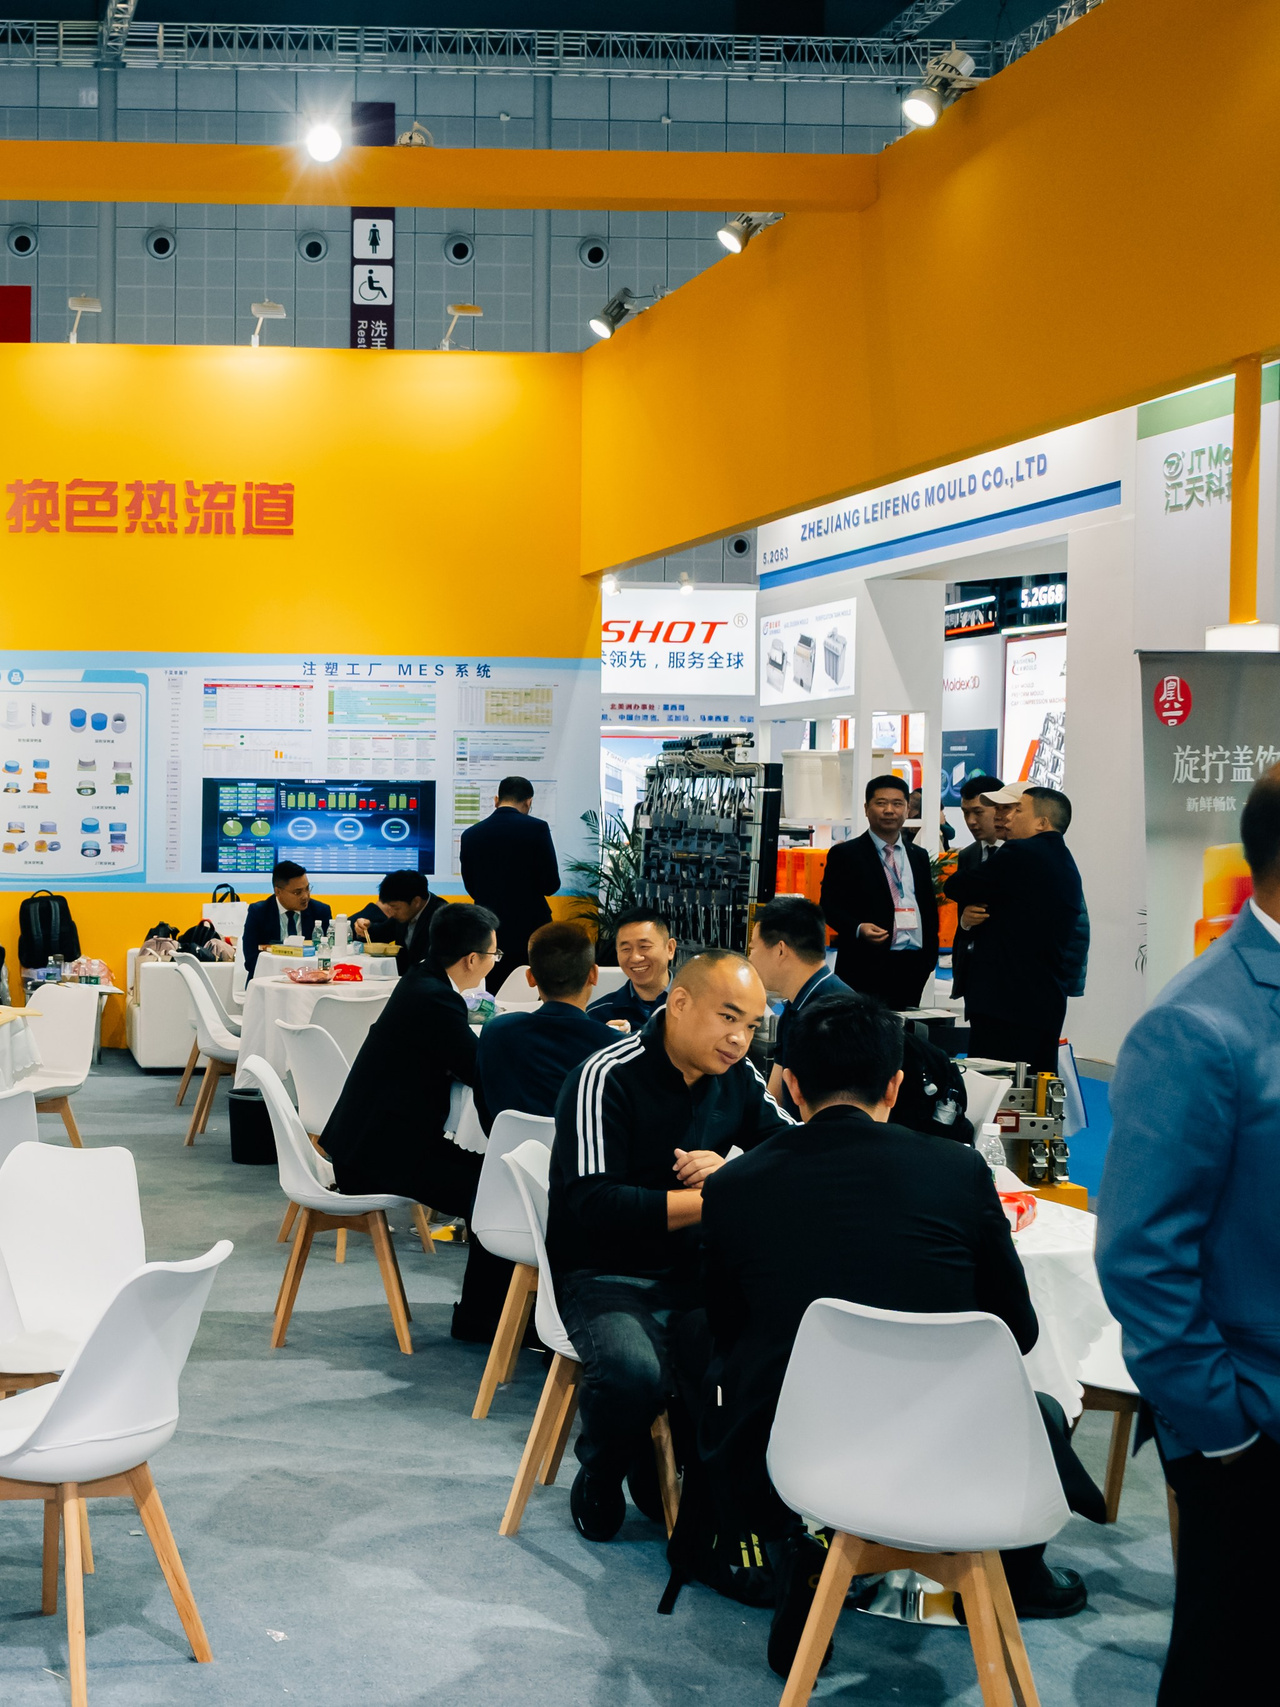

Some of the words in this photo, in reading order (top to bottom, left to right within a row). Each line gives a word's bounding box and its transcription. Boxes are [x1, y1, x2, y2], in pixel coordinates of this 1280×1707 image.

[1187, 448, 1206, 475] JT
[5, 478, 295, 536] 换色热流道
[800, 508, 860, 541] ZHEJIANG
[863, 490, 921, 524] LEIFENG
[924, 474, 977, 507] MOULD
[982, 453, 1048, 491] CO.,LTD
[763, 547, 789, 564] 5.2G63
[1020, 584, 1065, 609] 5.2G68
[303, 661, 382, 676] 注塑工厂
[398, 663, 444, 676] MES
[455, 663, 491, 678] 系统
